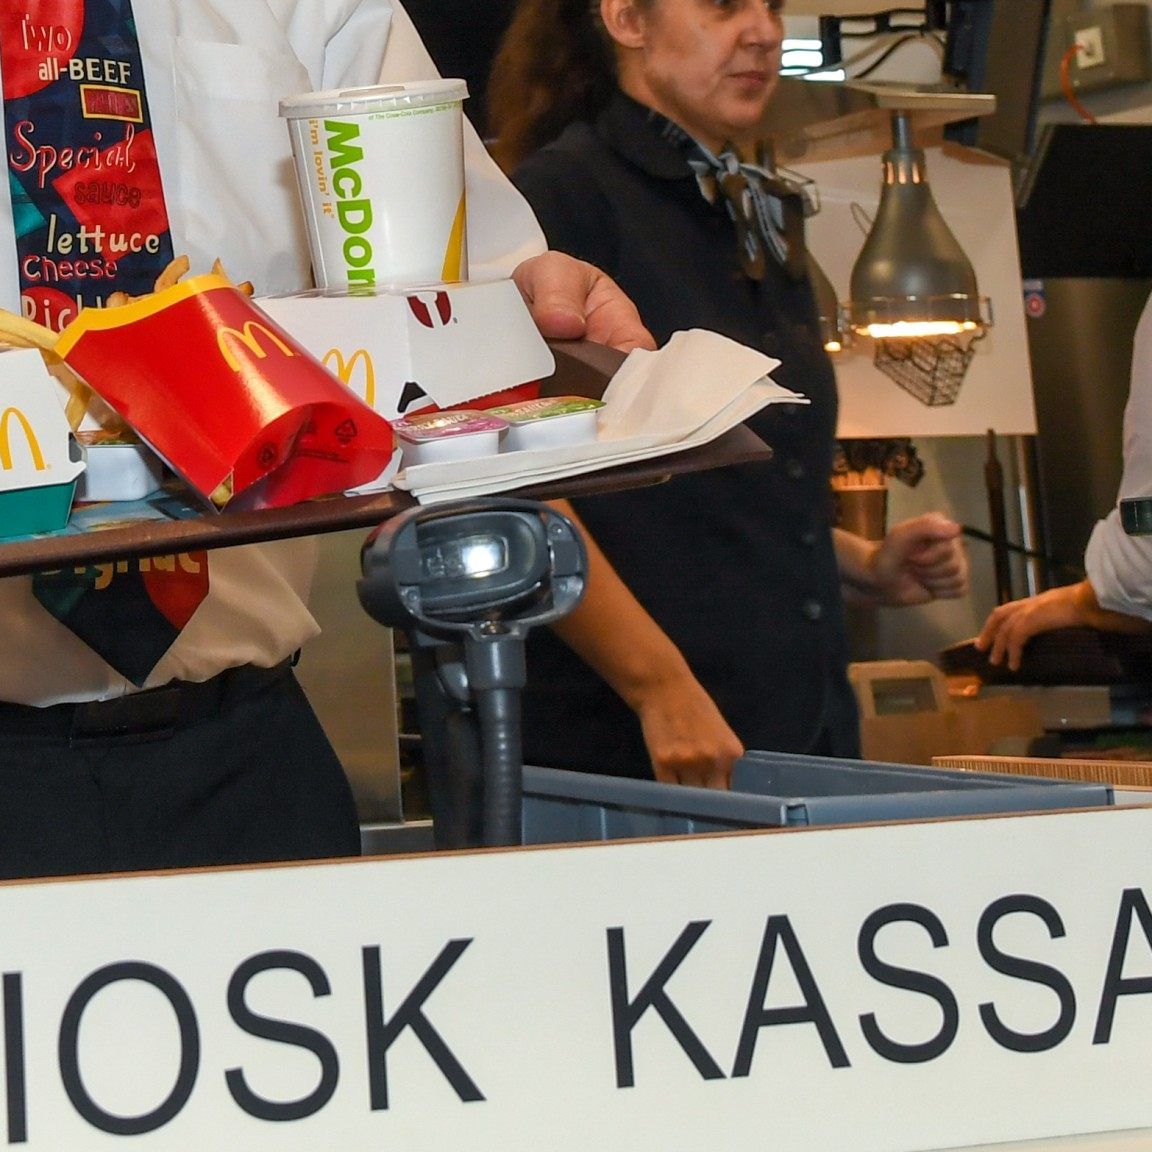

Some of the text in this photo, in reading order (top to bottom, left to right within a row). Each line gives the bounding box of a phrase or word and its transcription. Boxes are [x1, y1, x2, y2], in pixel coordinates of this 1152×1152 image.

[38, 57, 131, 85] all-BEEF
[308, 119, 319, 145] i'm
[10, 120, 136, 188] Special
[313, 151, 331, 196] lovin'
[74, 181, 142, 209] sauce
[46, 213, 160, 255] lettuce
[22, 254, 118, 282] Cheese
